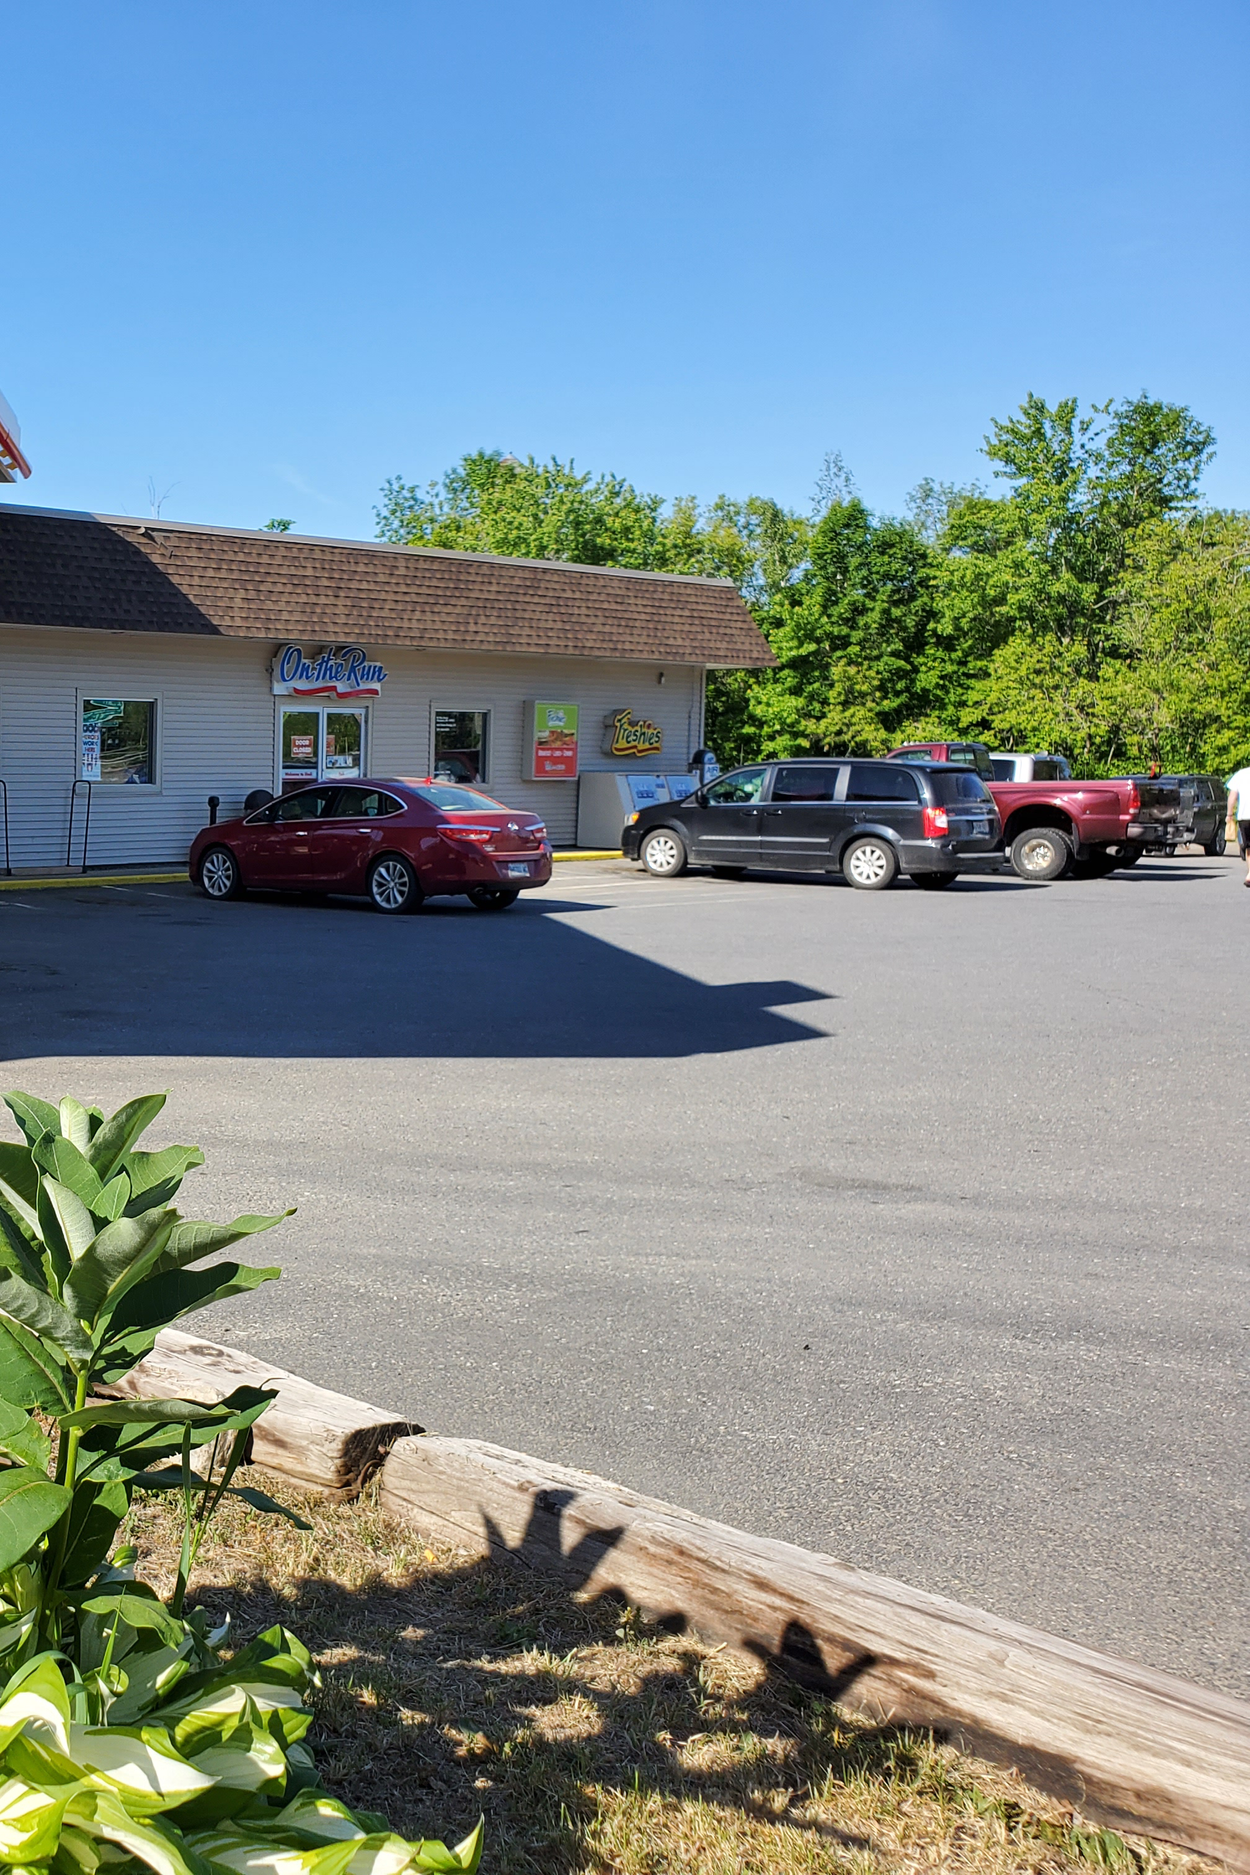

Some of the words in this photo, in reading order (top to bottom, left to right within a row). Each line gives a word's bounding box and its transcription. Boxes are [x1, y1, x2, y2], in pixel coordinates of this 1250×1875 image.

[280, 645, 315, 682] On
[314, 646, 347, 682] the
[341, 646, 389, 687] Run
[615, 711, 661, 746] Freshies
